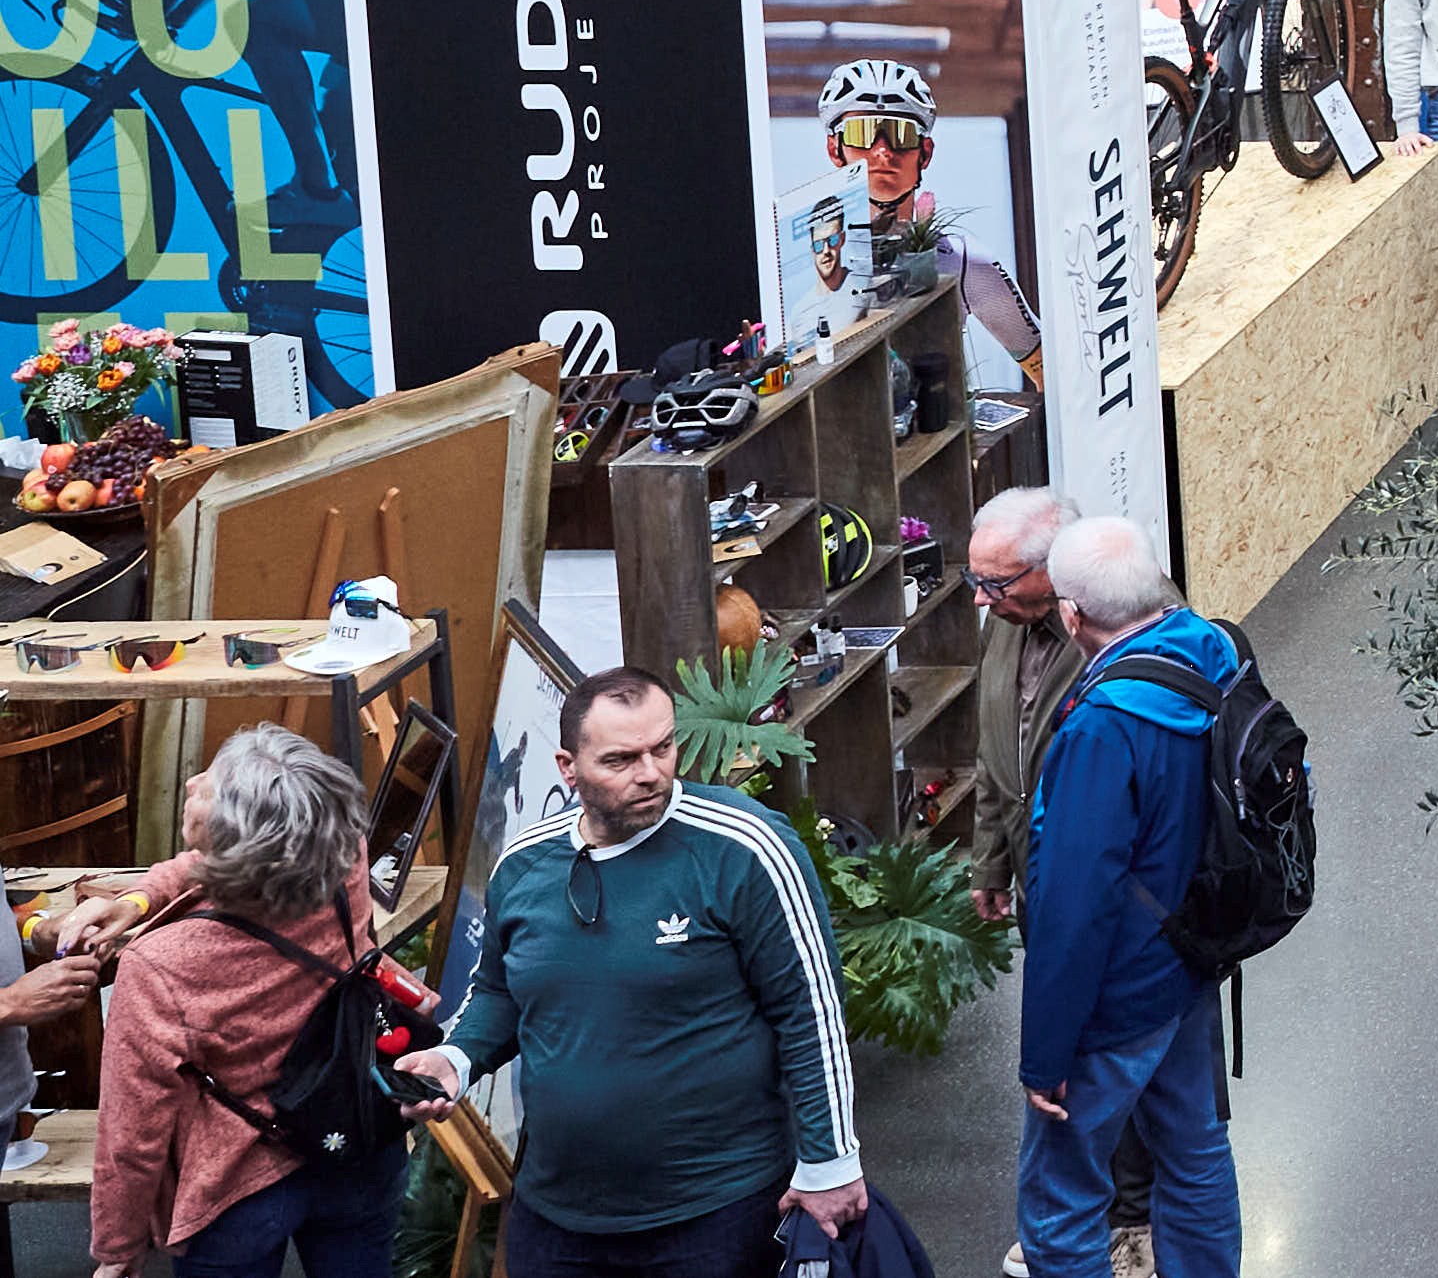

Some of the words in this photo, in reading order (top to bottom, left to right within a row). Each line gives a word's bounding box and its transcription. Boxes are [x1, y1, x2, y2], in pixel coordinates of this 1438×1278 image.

[33, 108, 323, 282] ILL
[1089, 138, 1134, 418] SEHWELT
[291, 366, 302, 414] RUDY
[655, 934, 689, 945] adidas
